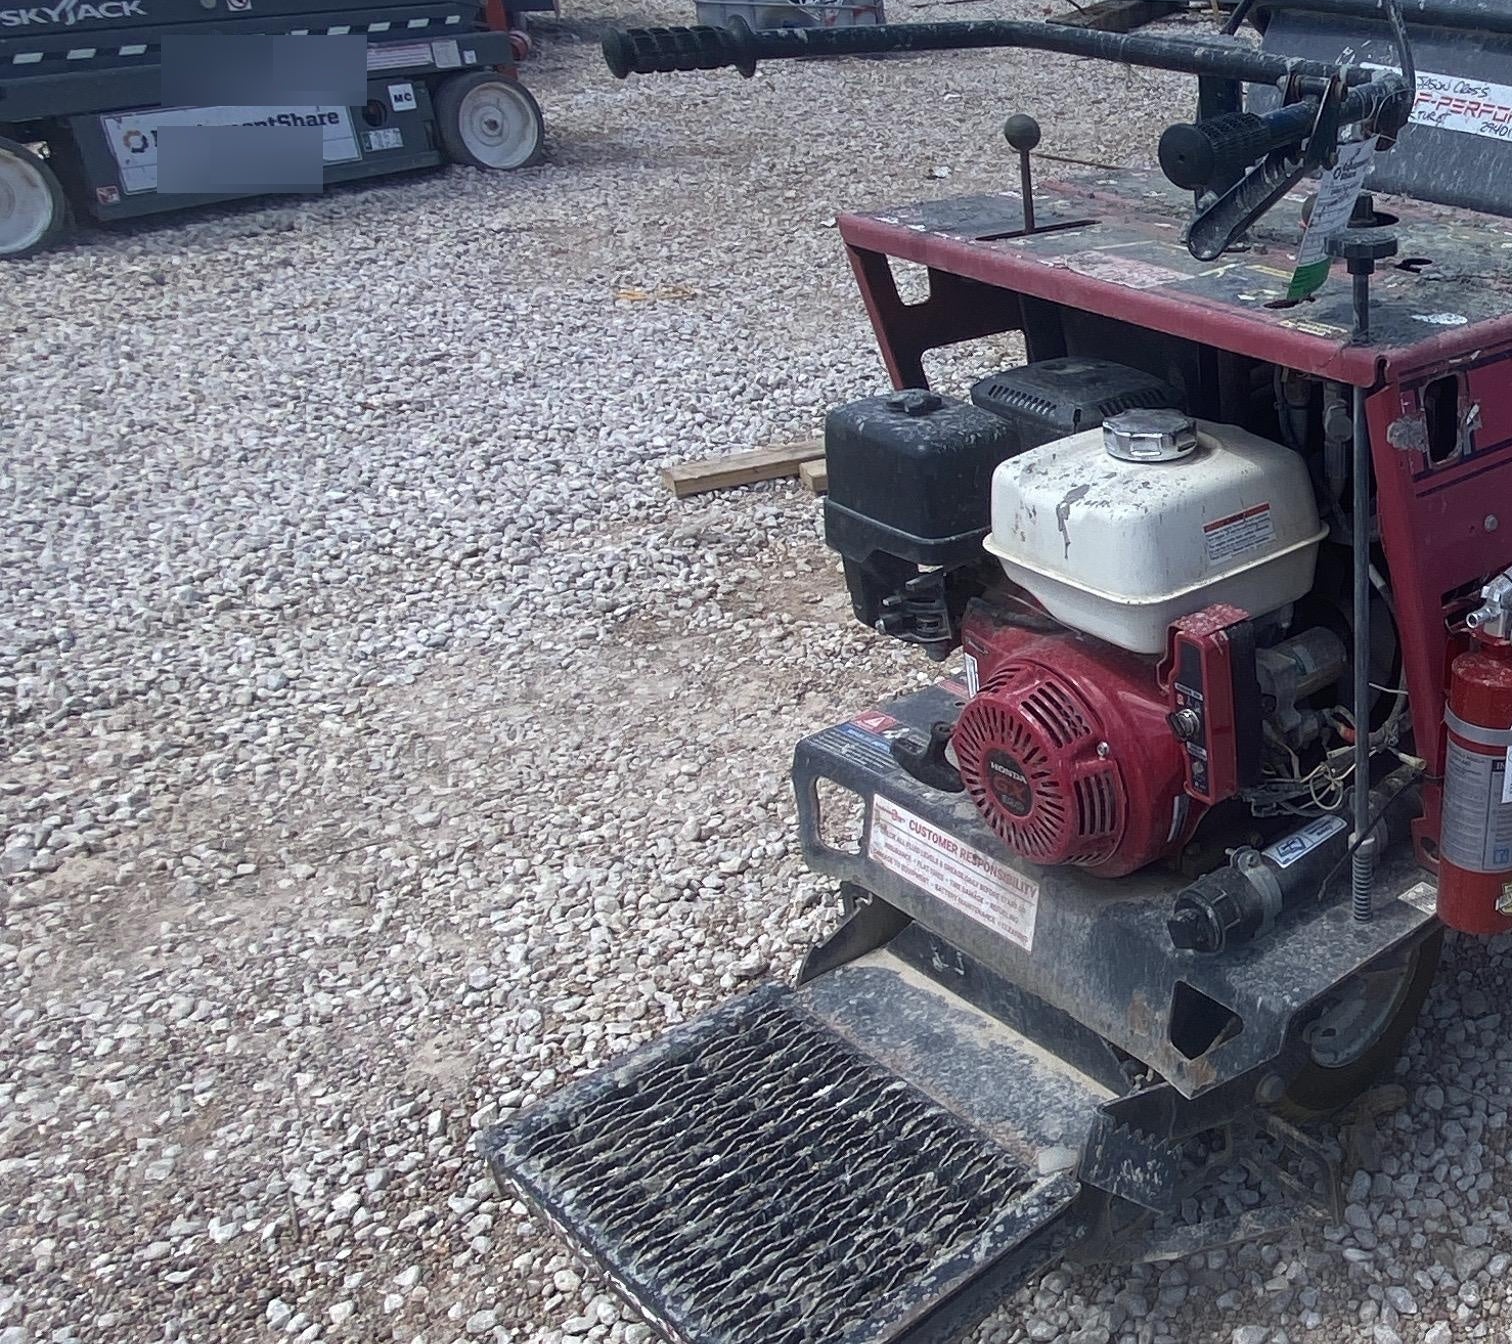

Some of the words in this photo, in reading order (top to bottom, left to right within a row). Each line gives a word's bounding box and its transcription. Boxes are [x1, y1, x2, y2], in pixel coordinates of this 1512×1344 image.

[394, 93, 412, 103] MC
[990, 760, 1028, 784] HONDA
[909, 819, 959, 856] CUSTOMER
[961, 845, 1038, 897] RESPONSIBILITY
